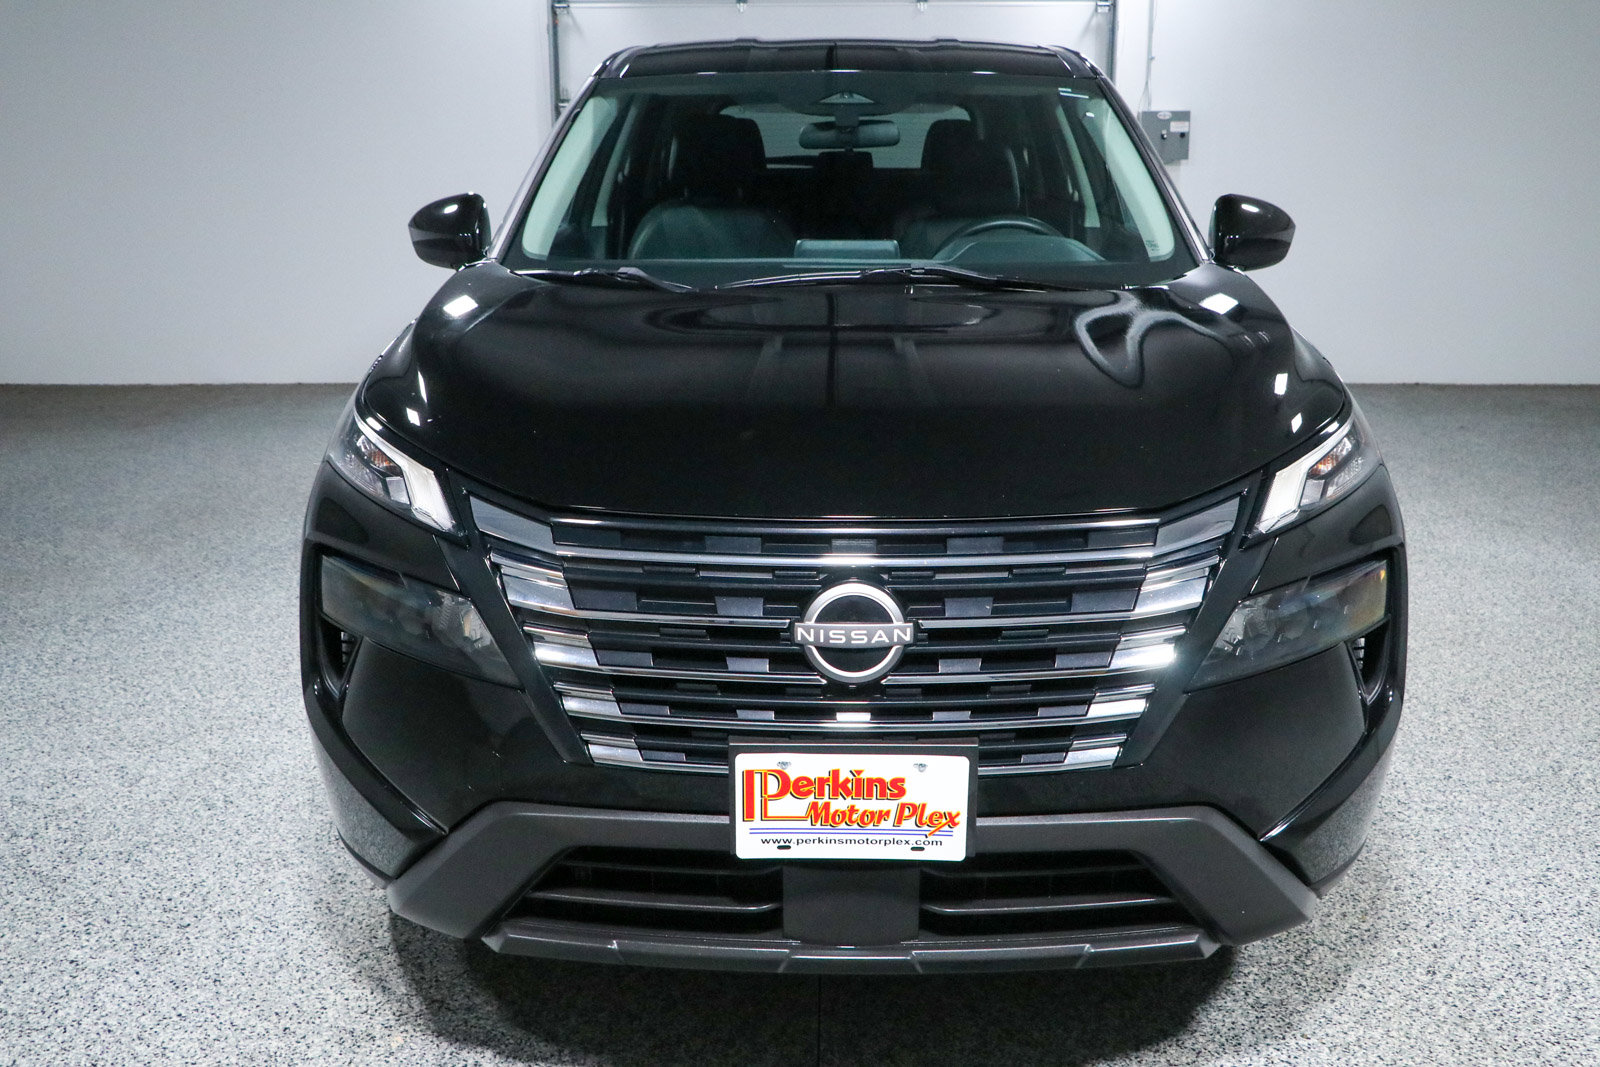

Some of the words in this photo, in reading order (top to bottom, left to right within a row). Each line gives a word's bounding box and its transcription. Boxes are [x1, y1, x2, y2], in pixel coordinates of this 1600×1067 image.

[797, 627, 911, 644] NISSAN
[742, 768, 907, 802] Perkins
[806, 801, 891, 828] Motor
[893, 802, 961, 834] Plex
[760, 835, 943, 847] www.perkinsmotorplex.com
